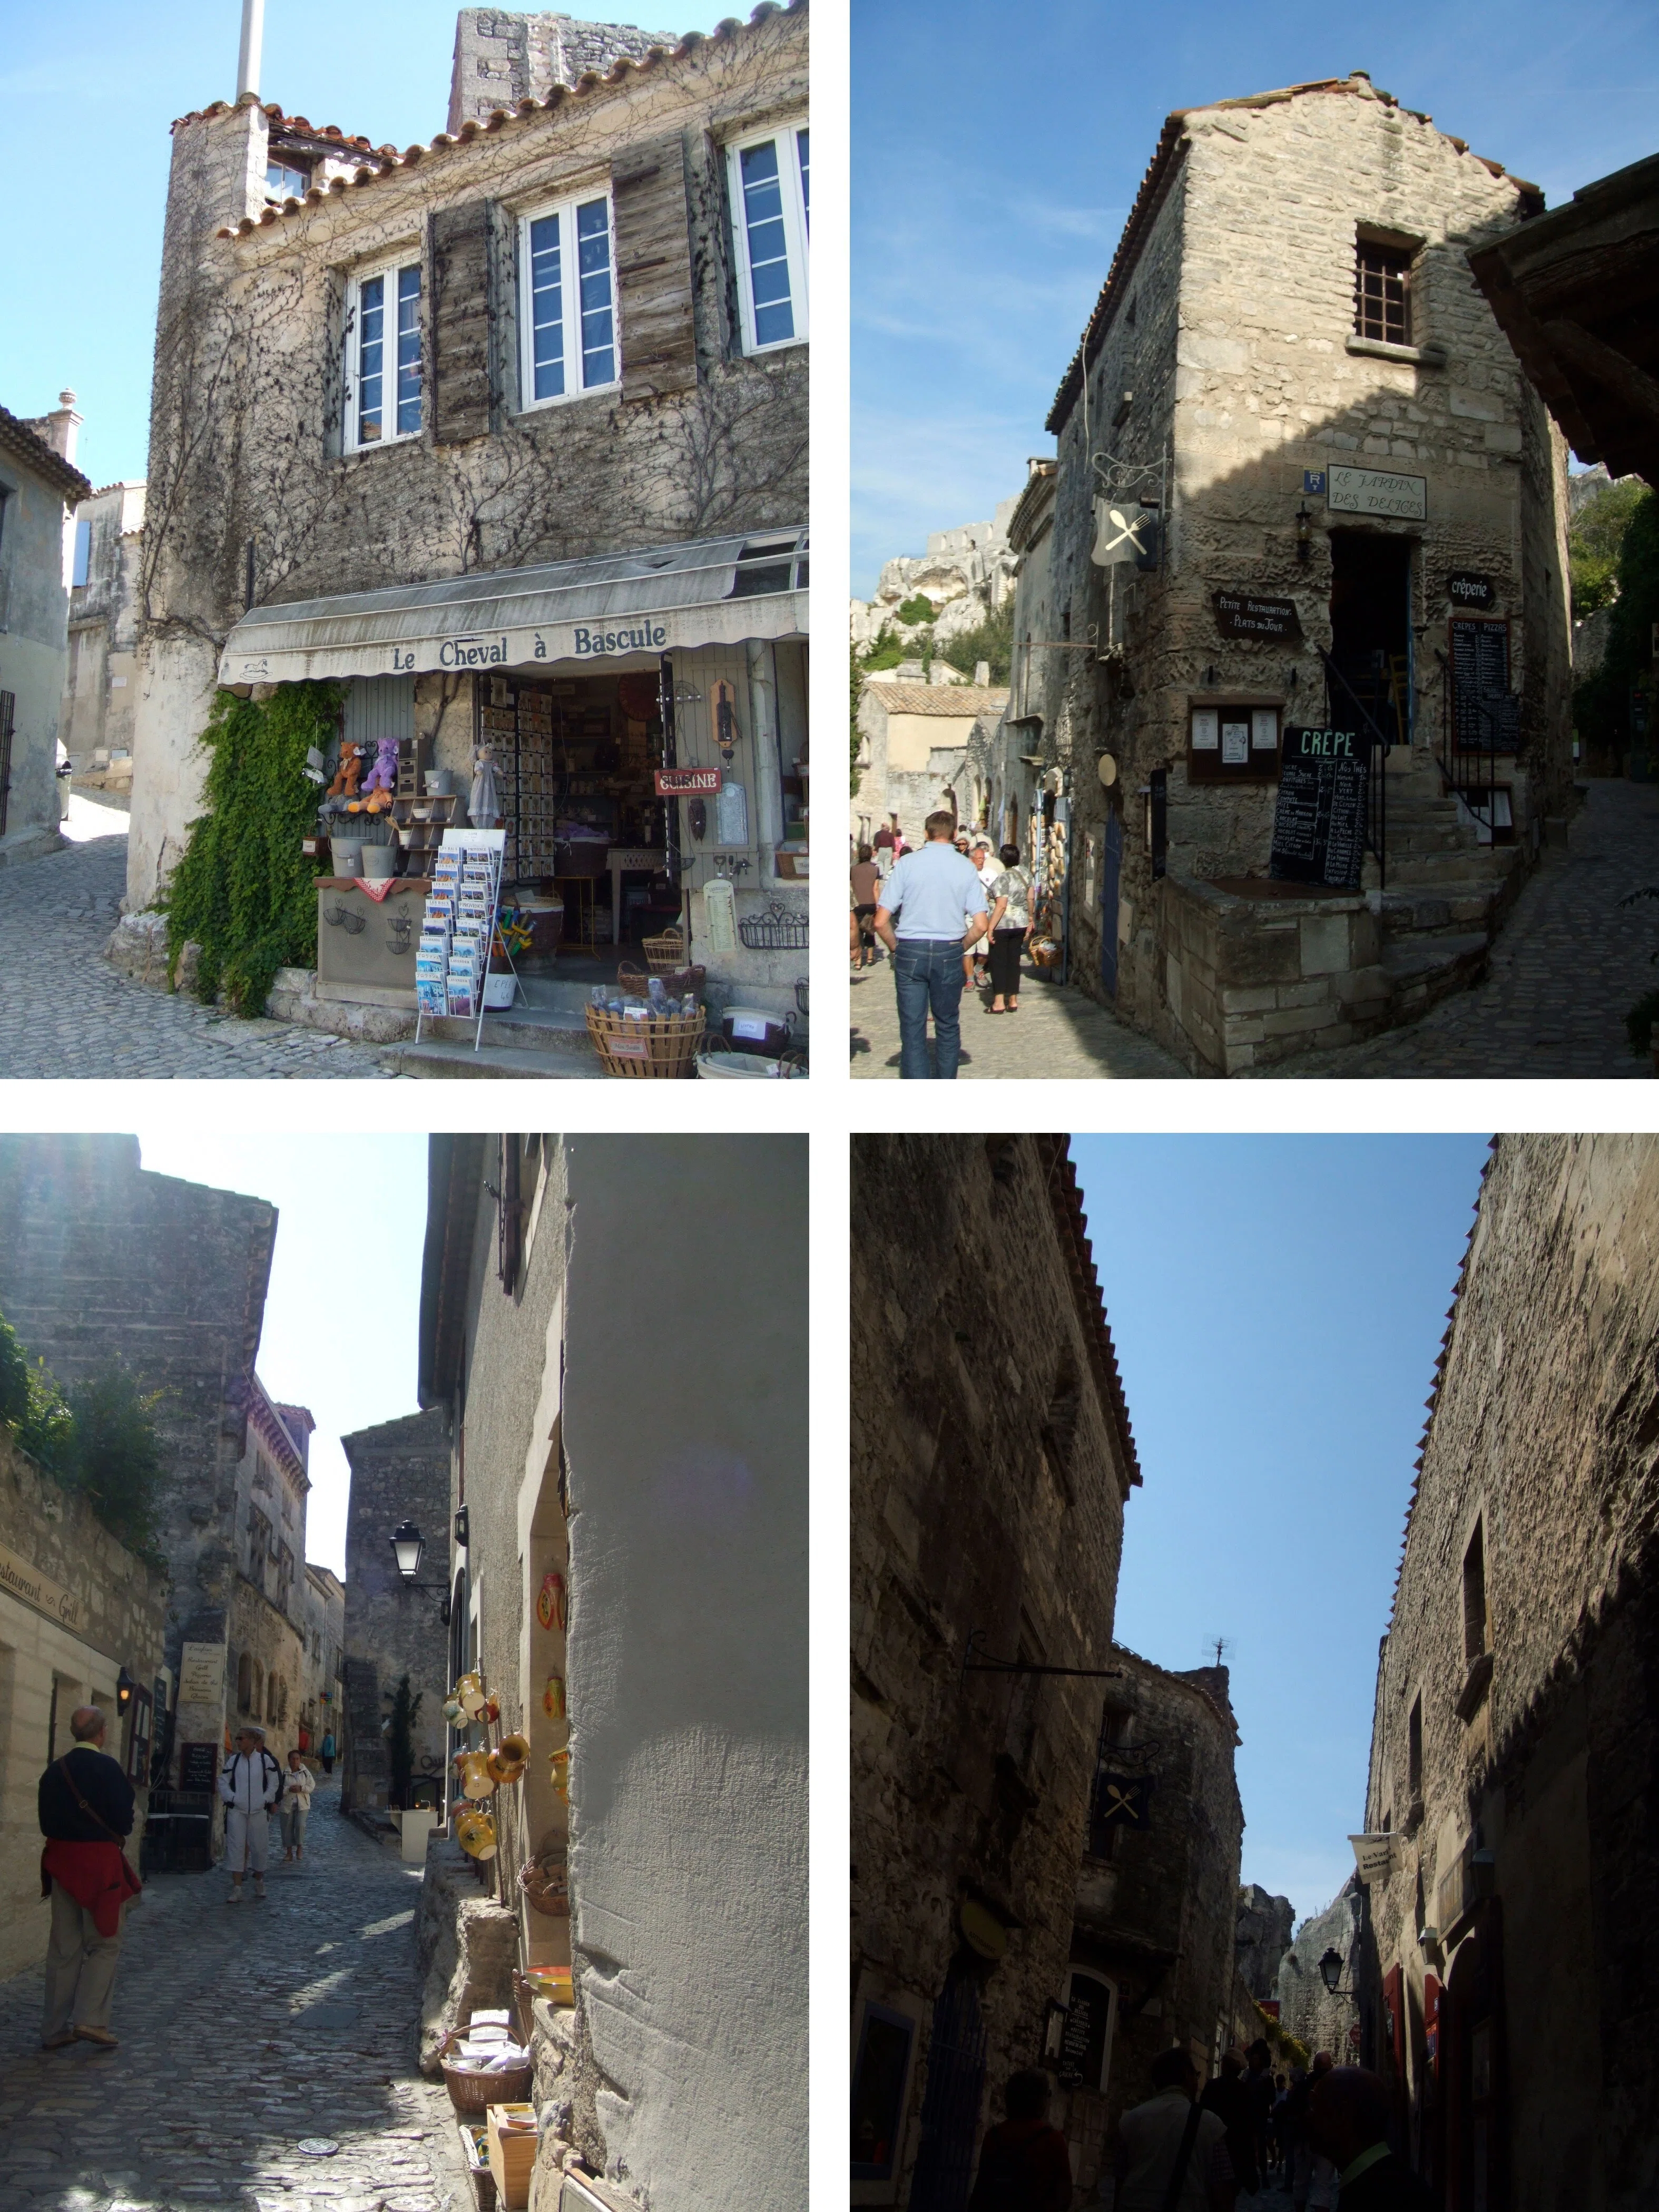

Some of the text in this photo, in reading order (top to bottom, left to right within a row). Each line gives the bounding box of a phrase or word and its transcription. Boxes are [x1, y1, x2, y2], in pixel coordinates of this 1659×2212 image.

[1334, 472, 1421, 496] LE JARDIN
[1332, 492, 1359, 510] DES
[1451, 578, 1487, 600] crêperie
[1220, 596, 1290, 615] PETITE RESTAURATION
[1234, 614, 1255, 628] PLATS
[1264, 618, 1283, 632] JOUR
[1483, 623, 1507, 631] PIZZAS
[393, 619, 666, 670] Le Cheval à Bascule
[1301, 728, 1356, 756] CRÊPE
[660, 773, 716, 790] CUISINE
[0, 1561, 79, 1626] staurant Grill
